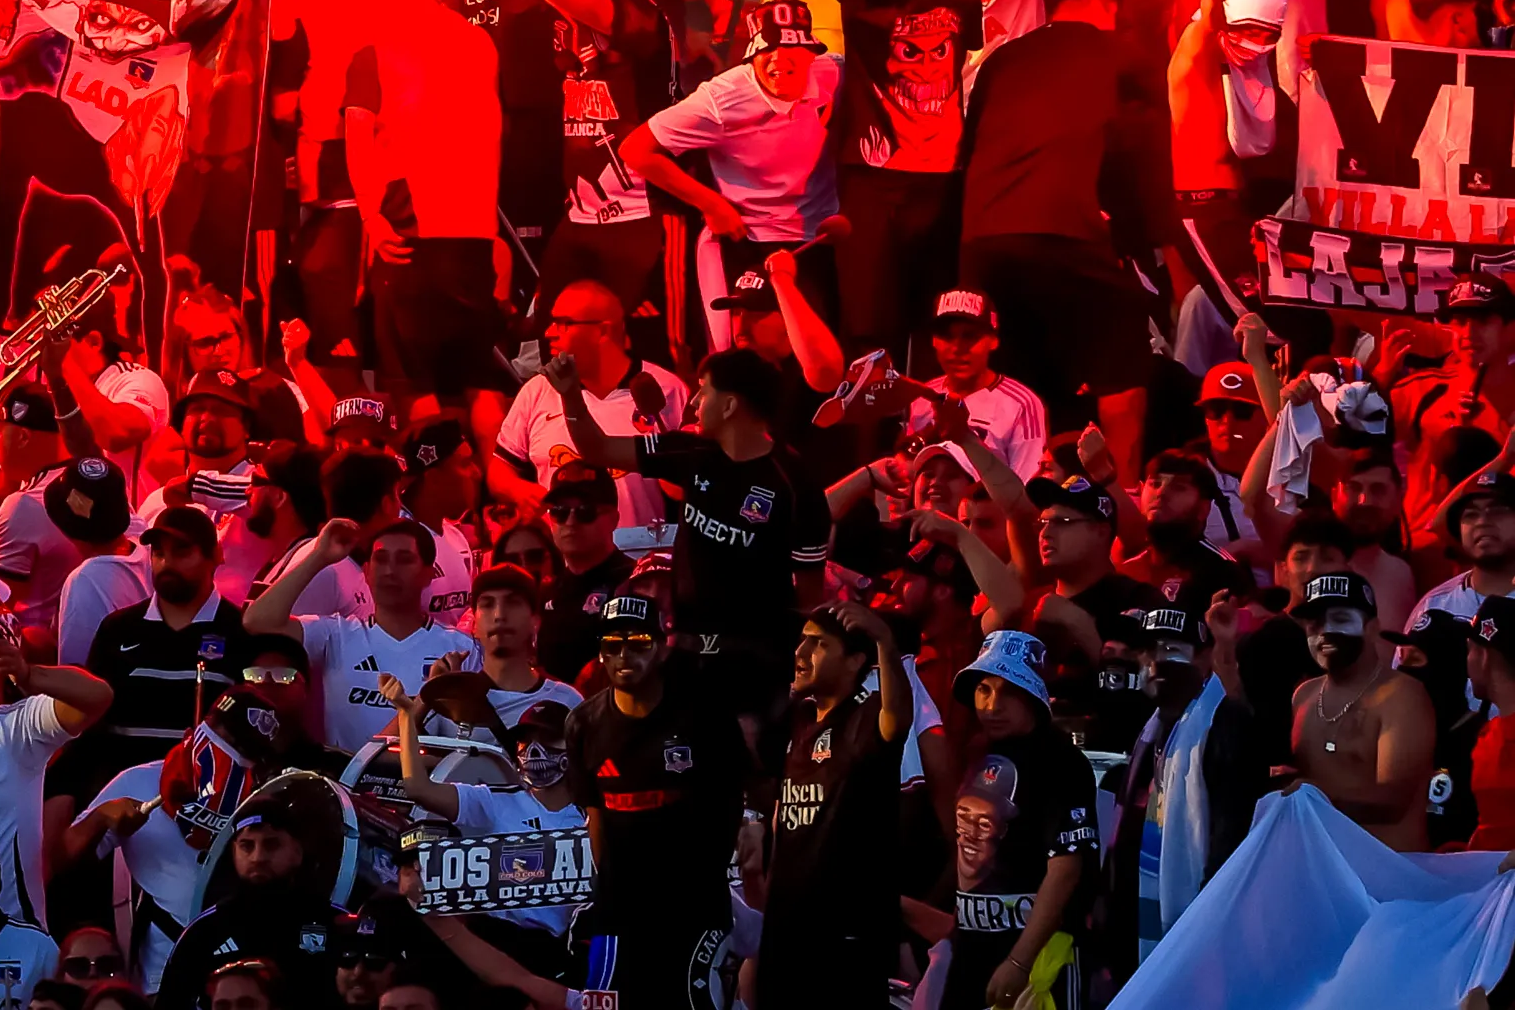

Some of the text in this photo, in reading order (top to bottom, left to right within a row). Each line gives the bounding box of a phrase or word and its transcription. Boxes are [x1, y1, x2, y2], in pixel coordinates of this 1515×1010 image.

[65, 72, 128, 116] LAD
[1303, 187, 1456, 242] VILLA
[684, 503, 756, 547] DRECTV
[782, 779, 824, 804] ilsen
[197, 812, 228, 829] JUG
[401, 832, 423, 848] COLO
[419, 846, 491, 891] LOS
[456, 888, 490, 904] LA
[498, 880, 593, 899] OCTAVA
